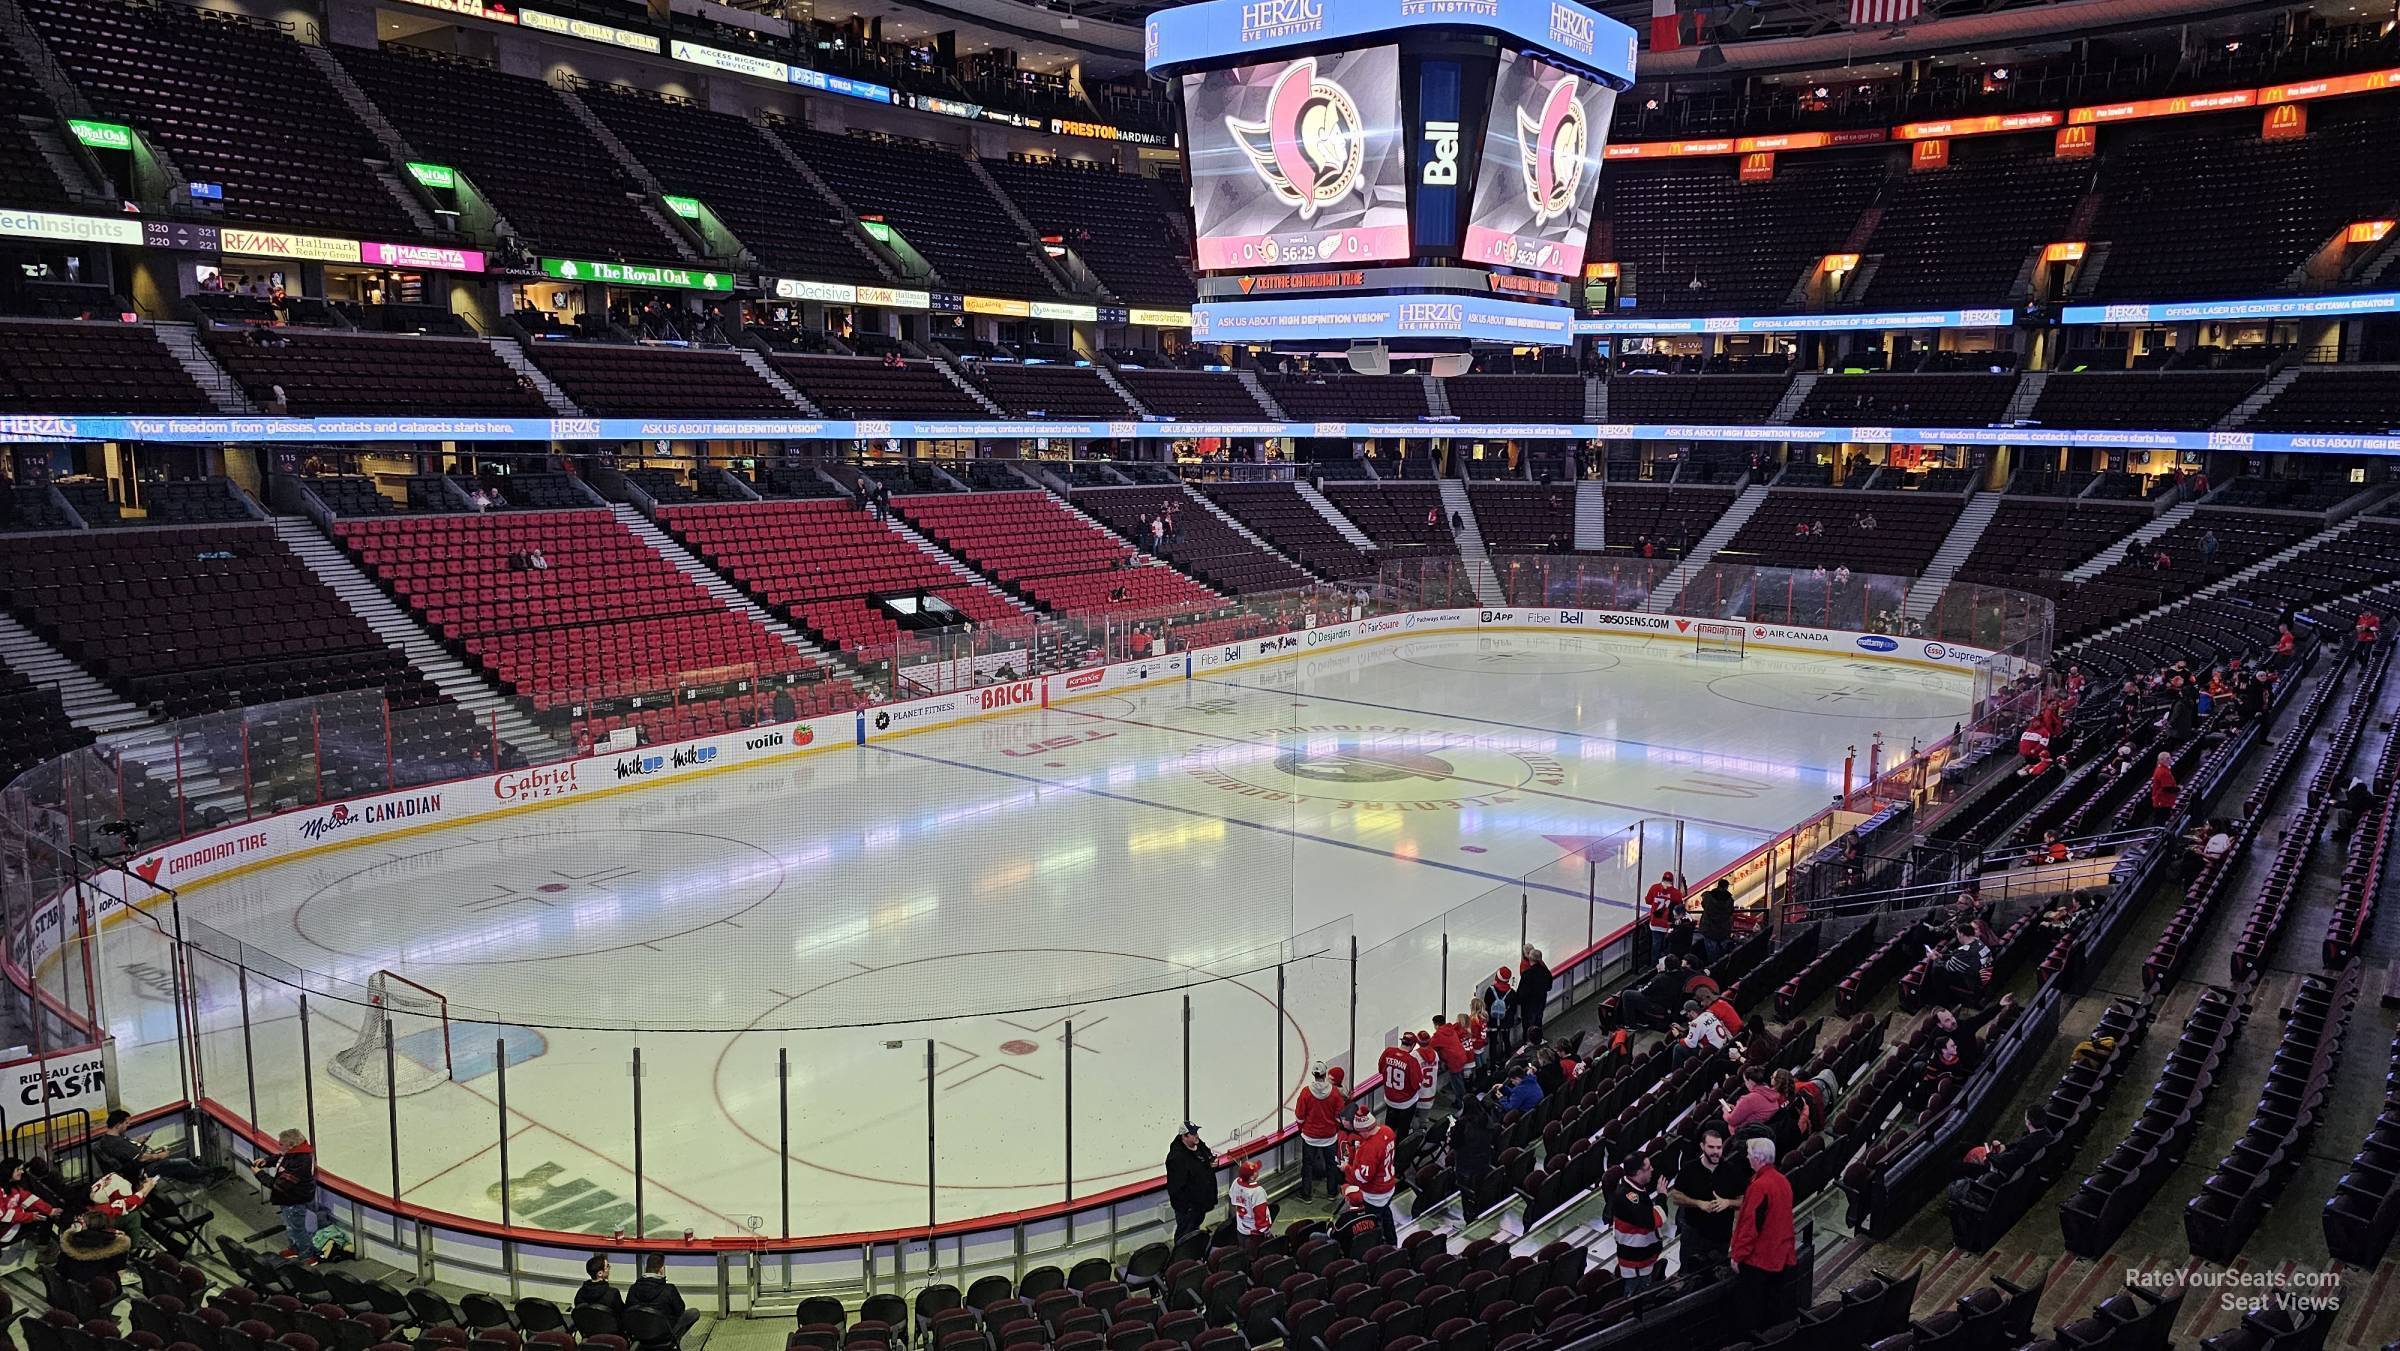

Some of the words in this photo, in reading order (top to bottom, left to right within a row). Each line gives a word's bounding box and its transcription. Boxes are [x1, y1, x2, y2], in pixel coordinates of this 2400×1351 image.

[1242, 0, 1323, 29] HERZIG
[1402, 4, 1425, 16] EYE
[1431, 2, 1497, 16] INSTITUTE
[1242, 30, 1261, 42] EYE
[1266, 21, 1322, 38] INSTITUTE
[1551, 5, 1594, 43] HERZIG
[1550, 29, 1561, 42] EYE
[1562, 32, 1593, 55] INSTITUTE
[700, 48, 732, 61] ACCESS
[716, 58, 756, 73] SERVICES
[1063, 121, 1117, 141] PRESTON
[1423, 122, 1459, 185] Bell
[0, 211, 123, 238] echInsights
[148, 223, 169, 234] 320
[198, 227, 216, 238] 321
[149, 237, 170, 247] 220
[200, 241, 217, 251] 221
[224, 233, 290, 254] RE/MAX
[295, 237, 356, 252] Hallmark
[1243, 244, 1252, 260] 0
[1282, 246, 1316, 261] 56:29
[1347, 237, 1358, 253] 0
[296, 248, 328, 260] Realty
[329, 250, 357, 261] Group
[398, 247, 464, 263] MAGENTA
[1494, 240, 1502, 256] 0
[1517, 249, 1537, 265] 56:29
[1552, 250, 1559, 265] 0
[505, 268, 529, 276] CAMERA
[590, 262, 620, 279] The
[622, 266, 661, 285] Royal
[663, 272, 690, 285] Oak
[795, 282, 851, 300] Decisive
[858, 288, 893, 303] RE/MAX
[1399, 304, 1463, 322] HERZIG
[2105, 305, 2149, 318] HERZIG
[2166, 307, 2201, 316] OFFICIAL
[2229, 306, 2246, 314] EYE
[2248, 304, 2281, 313] CENTRE
[2283, 304, 2296, 312] OF
[2297, 303, 2314, 311] THE
[2315, 301, 2350, 310] OTTAWA
[1218, 317, 1235, 326] ASK
[1235, 317, 1247, 326] US
[1248, 317, 1277, 326] ABOUT
[1279, 315, 1299, 325] HIGH
[1301, 314, 1351, 325] DEFINITION
[1419, 322, 1462, 330] INSTITUTE
[1468, 313, 1480, 323] ASK
[1487, 315, 1504, 325] ABOUT
[0, 419, 77, 433] HERZIG
[132, 421, 166, 433] Your
[169, 420, 228, 433] freedom
[231, 421, 262, 433] from
[266, 422, 316, 435] glasses,
[318, 422, 372, 433] contacts
[374, 421, 397, 433] and
[399, 422, 452, 433] cataracts
[454, 422, 486, 433] starts
[551, 420, 600, 433] HERZIG
[641, 424, 662, 433] ASK
[663, 424, 677, 433] US
[679, 424, 711, 433] ABOUT
[713, 424, 735, 434] HIGH
[737, 424, 787, 434] DEFINITION
[856, 423, 891, 433] HERZIG
[914, 425, 929, 433] Your
[1367, 426, 1383, 434] Your
[1597, 425, 1634, 436] HERZIG
[1694, 429, 1721, 437] ABOUT
[1723, 429, 1742, 437] HIGH
[1920, 431, 1938, 440] Your
[1976, 432, 1996, 440] from
[2031, 433, 2068, 441] contacts
[2208, 433, 2254, 444] HERZIG
[2291, 438, 2312, 447] ASK
[2313, 438, 2326, 447] US
[2327, 438, 2361, 448] ABOUT
[2363, 439, 2386, 449] HIGH
[24, 457, 45, 465] 114
[1367, 619, 1399, 632] FairSquare
[1416, 615, 1439, 623] Pathways
[1440, 613, 1460, 621] Alliance
[1528, 613, 1550, 624] Fibe
[1560, 611, 1583, 625] Bell
[1318, 628, 1351, 645] Desjardins
[1769, 630, 1785, 638] AIR
[1786, 631, 1829, 642] CANADA
[1201, 653, 1218, 666] Fibe
[1224, 646, 1241, 663] Bell
[1927, 647, 1943, 655] Esso
[966, 693, 980, 705] The
[981, 682, 1034, 710] BRICK
[893, 707, 922, 721] PLANET
[924, 702, 955, 715] FITNESS
[746, 731, 783, 750] voilà
[494, 762, 577, 799] Gabriel
[521, 782, 578, 801] PIZZA
[299, 811, 360, 840] Molson
[365, 795, 441, 823] CANADIAN
[169, 841, 235, 875] CANADIAN
[237, 832, 268, 854] TIRE
[19, 1066, 69, 1085] RIDEAU
[1385, 1066, 1406, 1090] 19
